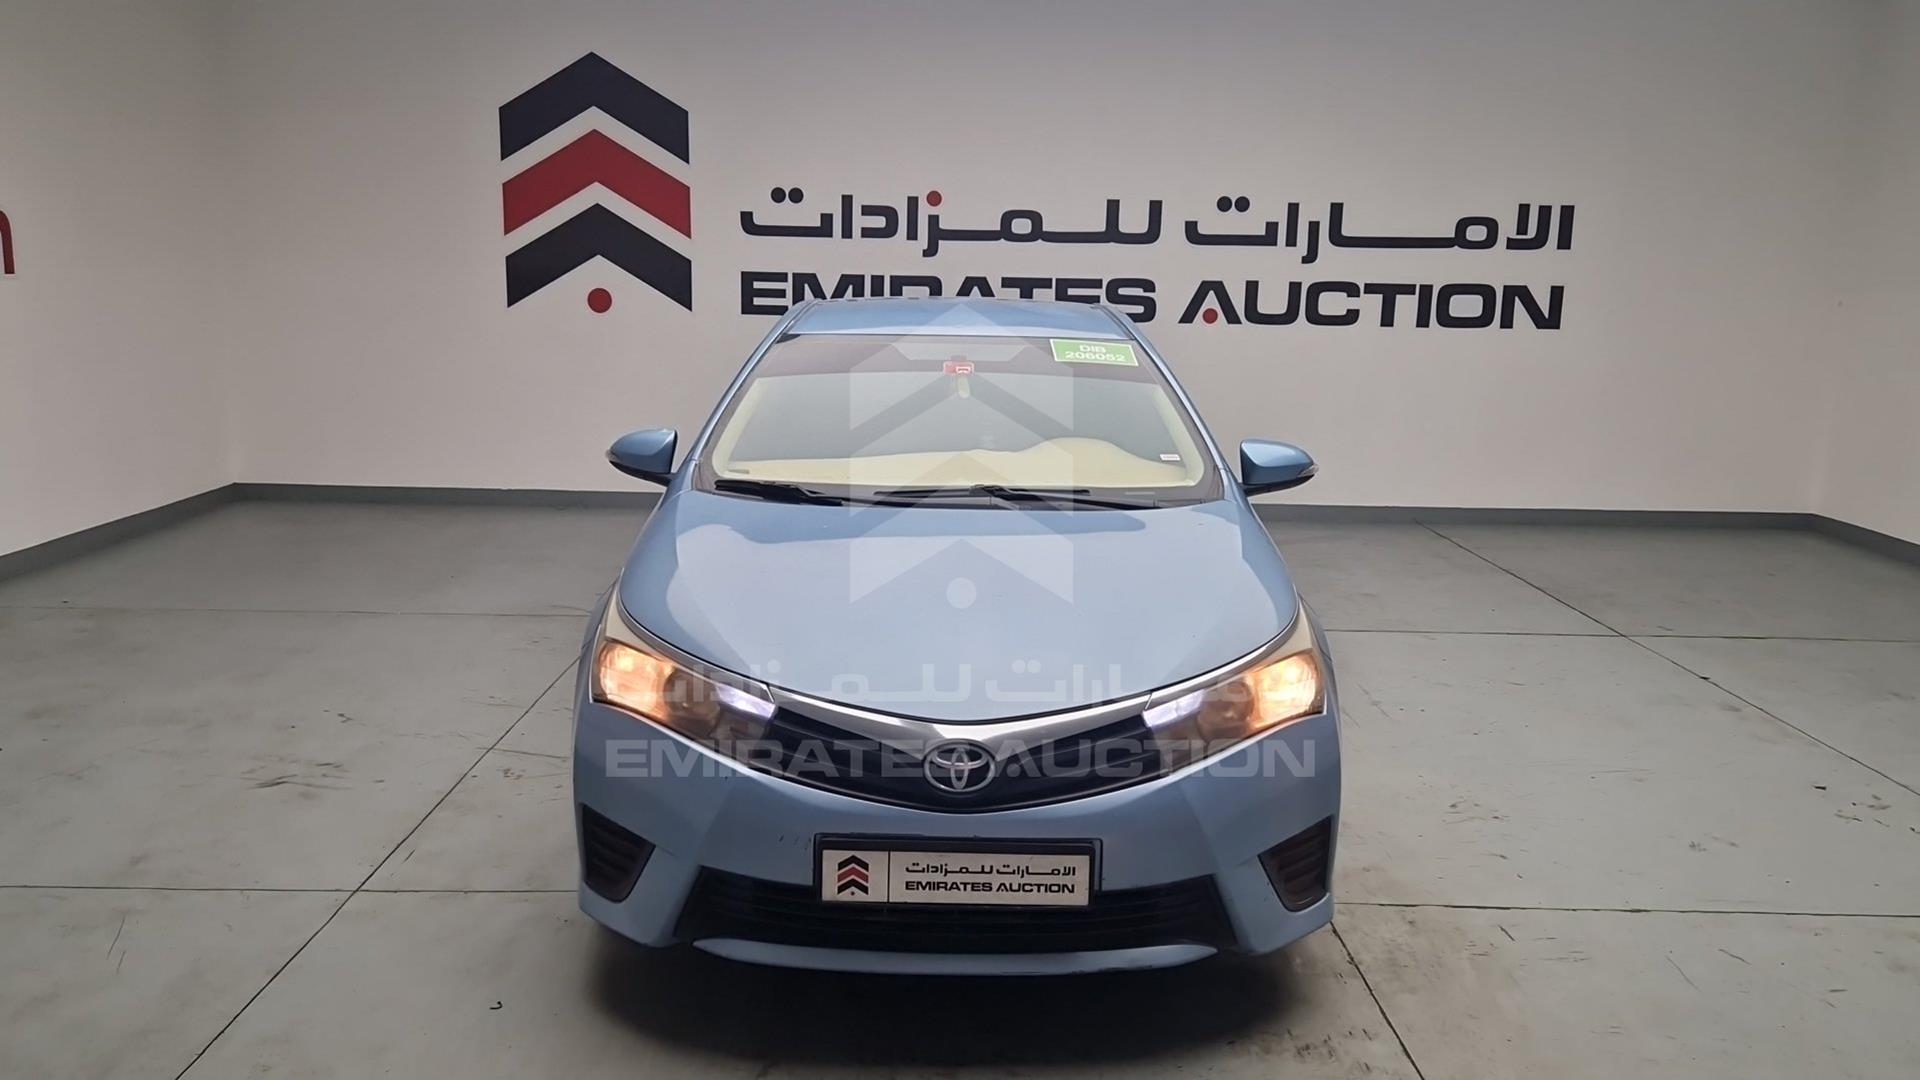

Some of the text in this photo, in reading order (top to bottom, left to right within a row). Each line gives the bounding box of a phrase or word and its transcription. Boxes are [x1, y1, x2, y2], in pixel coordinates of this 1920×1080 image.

[739, 186, 1576, 265] الامارات للمزادات
[1177, 280, 1565, 330] AUCTION
[905, 862, 1077, 878] الامارات للمزادات
[905, 881, 1075, 894] EMIRATES AUCTION
